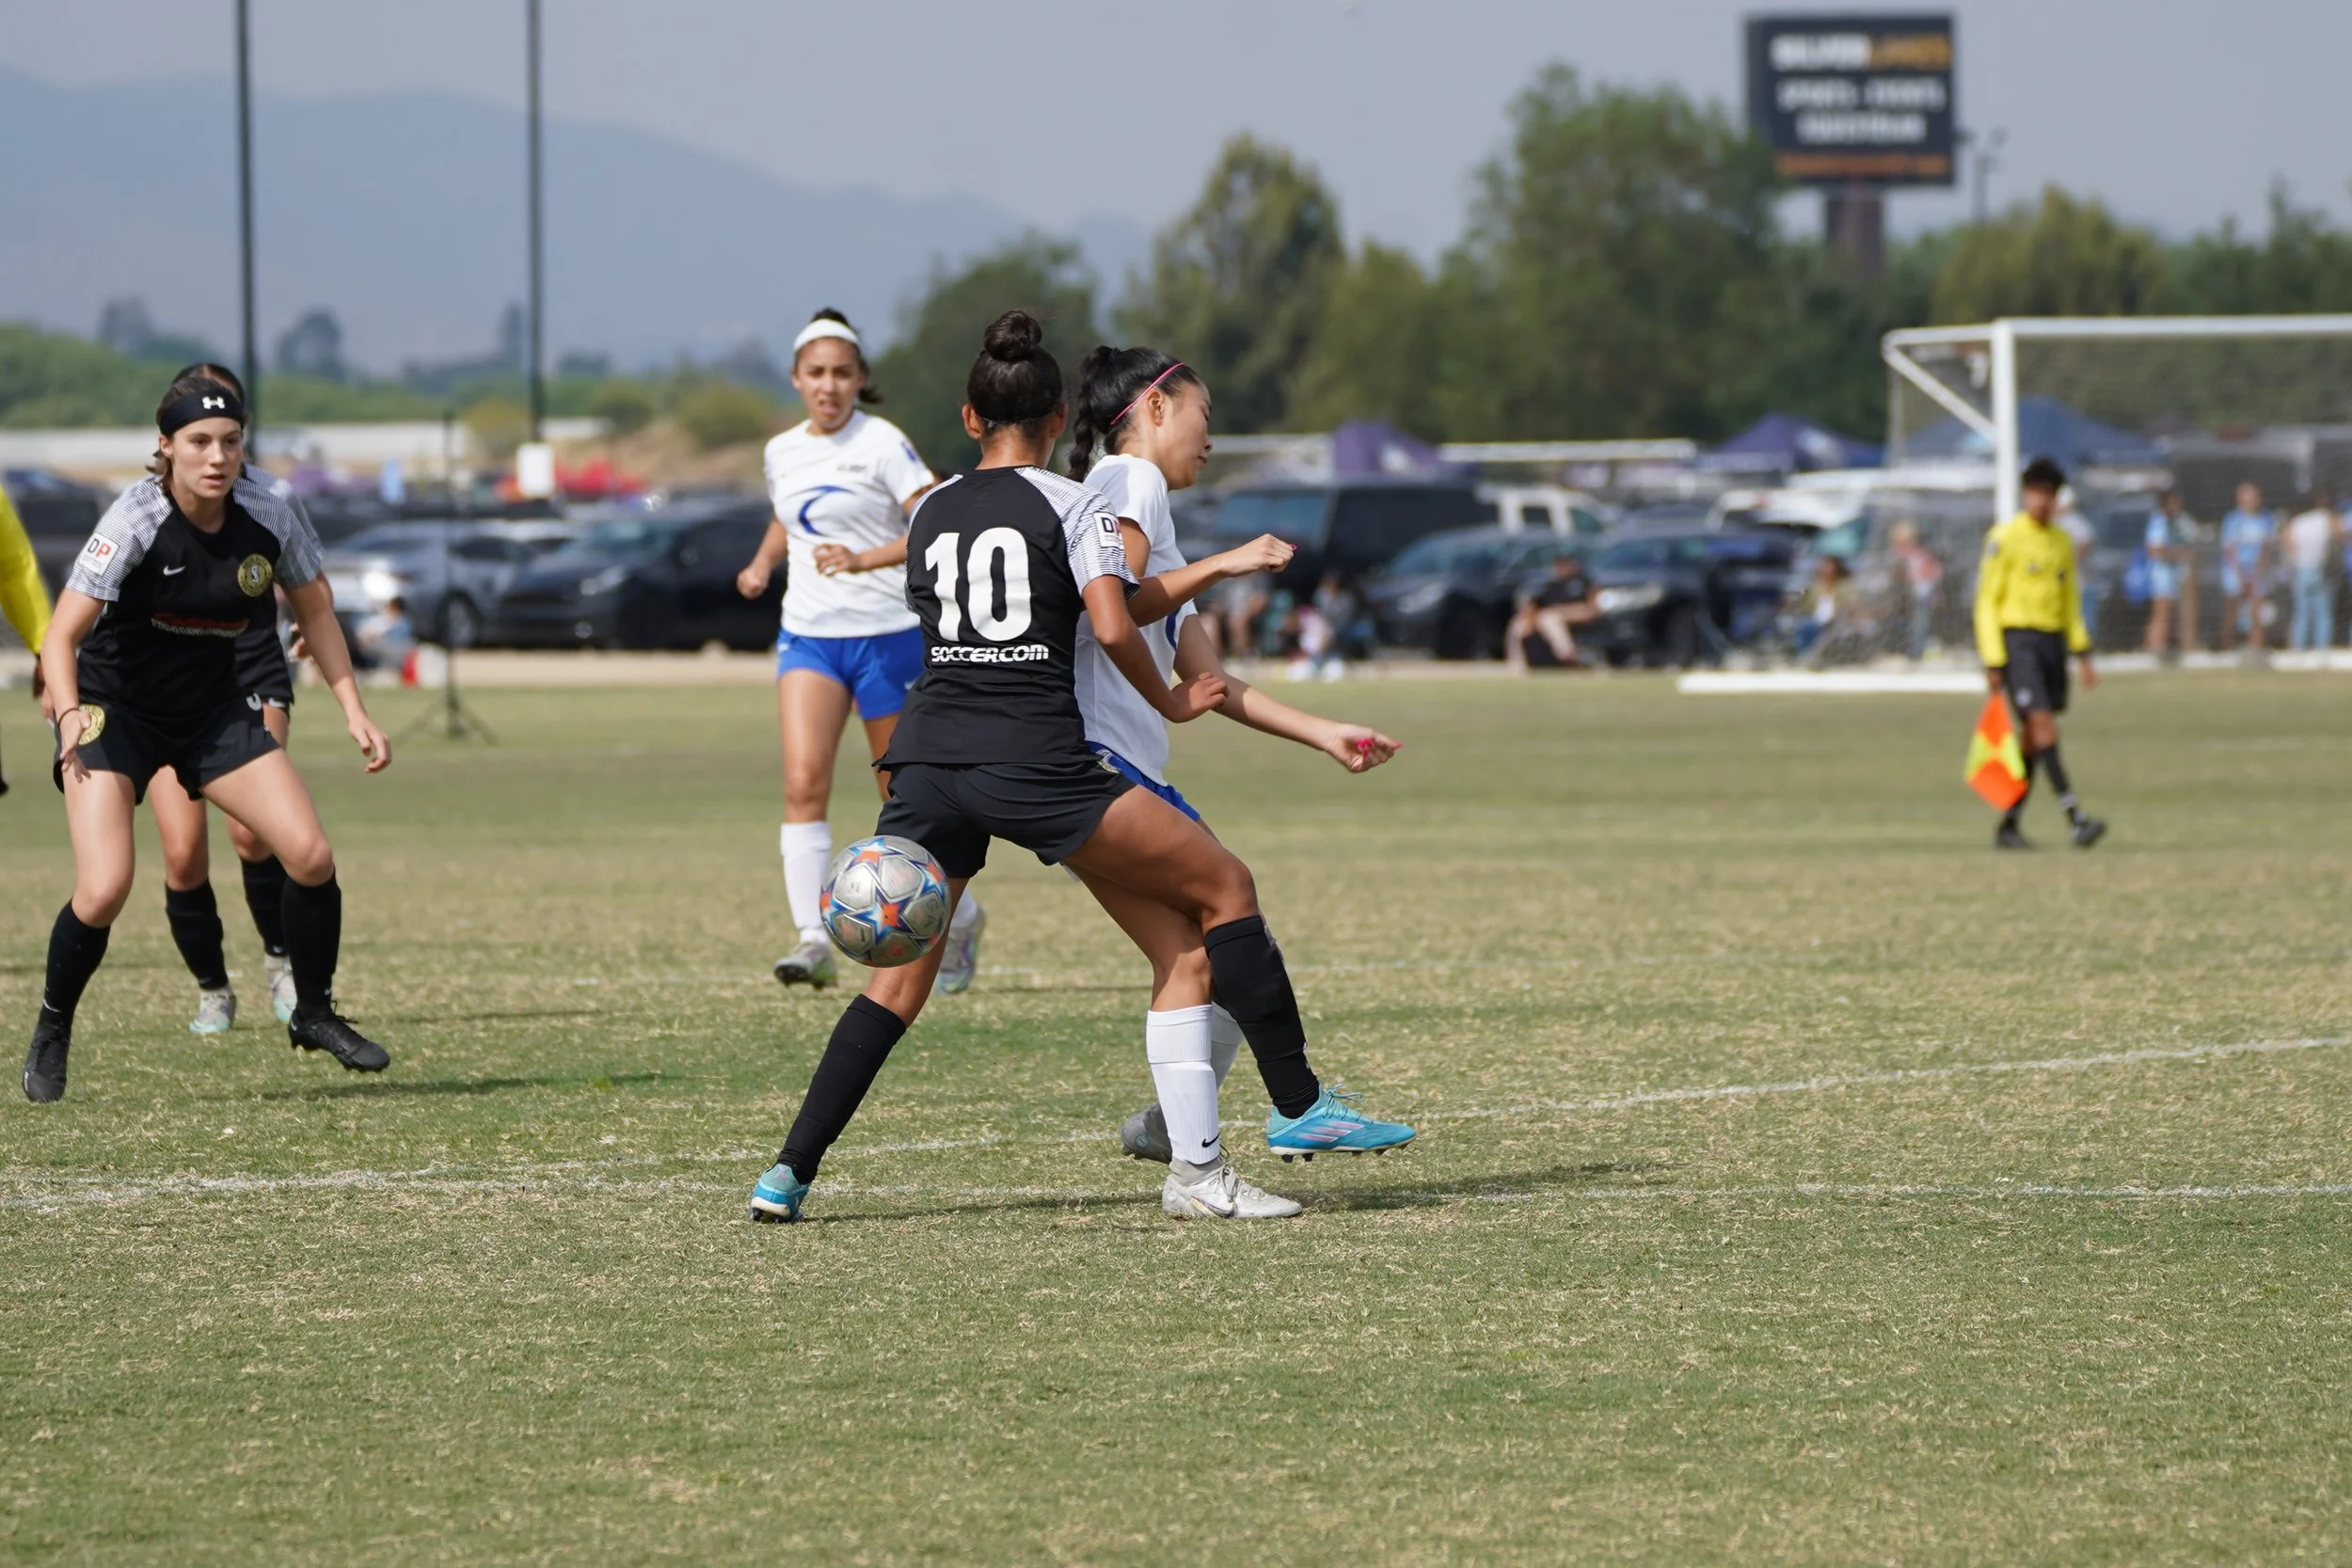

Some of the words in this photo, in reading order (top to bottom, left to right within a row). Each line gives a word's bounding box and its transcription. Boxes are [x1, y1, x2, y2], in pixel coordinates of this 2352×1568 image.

[87, 537, 112, 558] DP
[925, 527, 1031, 641] 10
[930, 644, 1049, 663] SOCCER.COM
